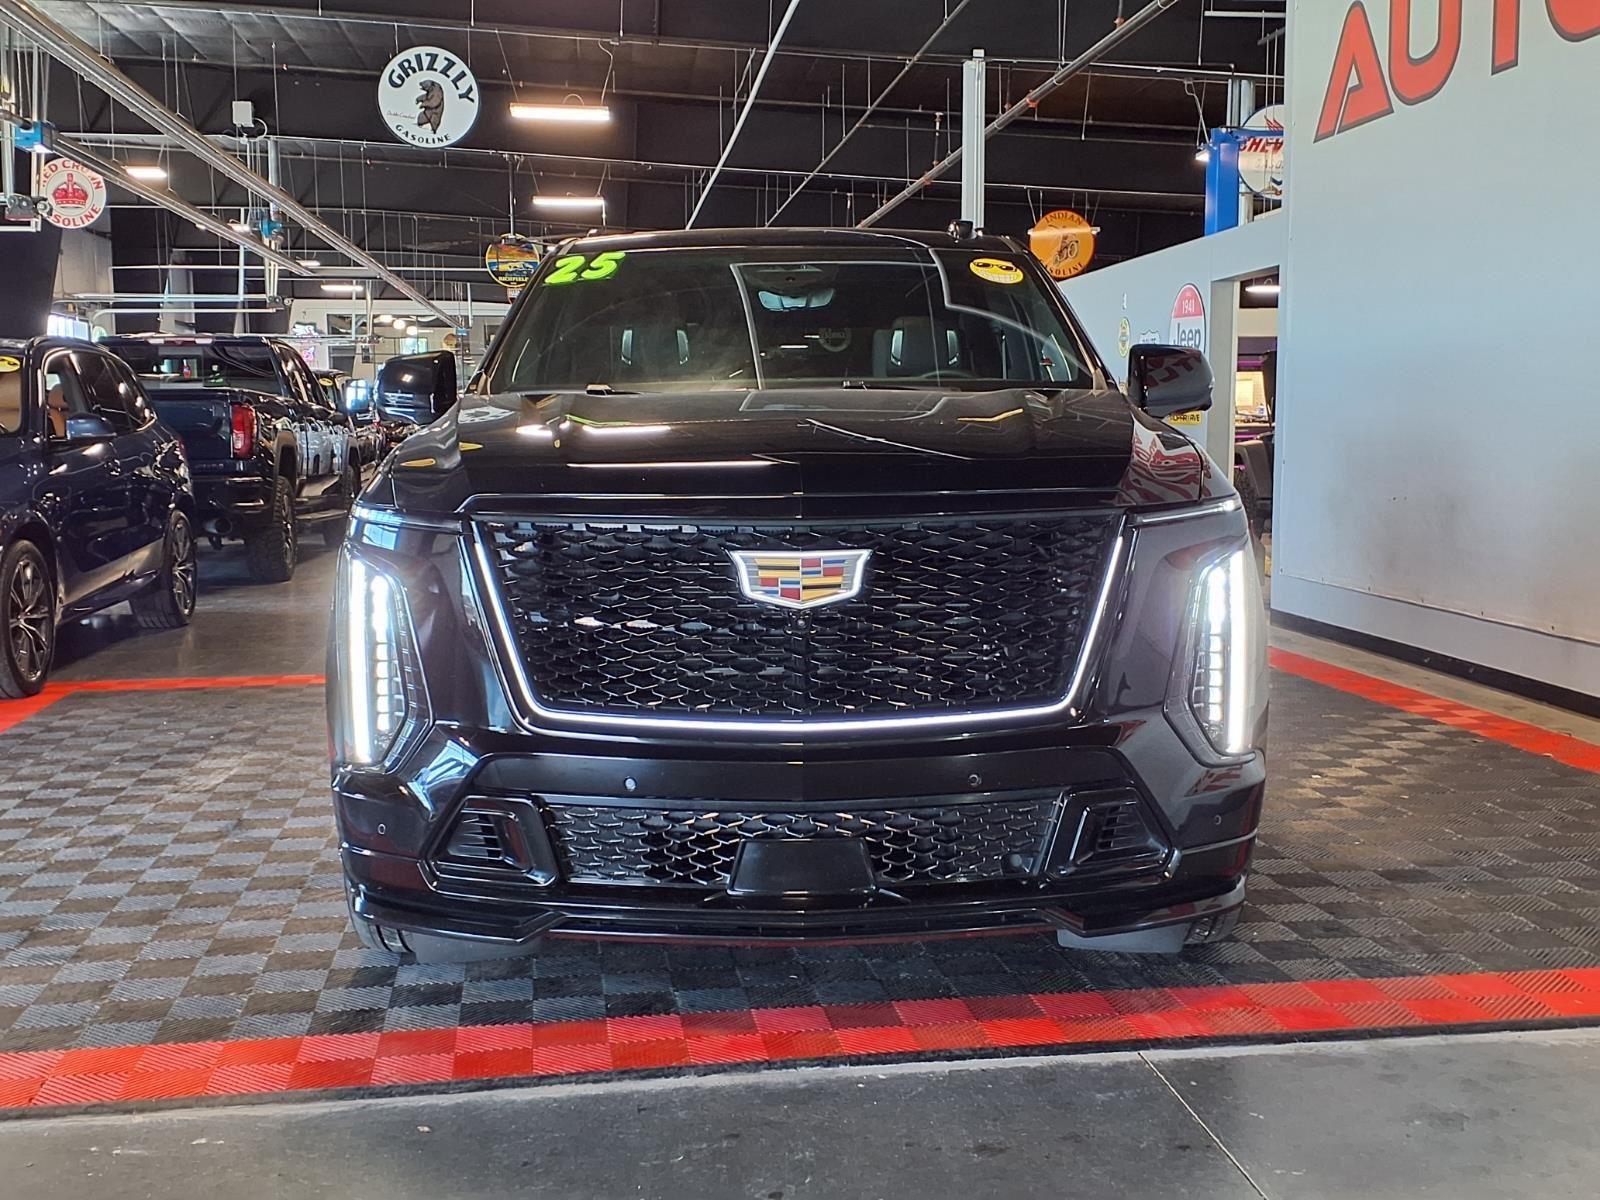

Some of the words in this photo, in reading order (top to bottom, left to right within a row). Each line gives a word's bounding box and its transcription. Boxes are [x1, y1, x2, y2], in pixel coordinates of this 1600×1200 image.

[388, 53, 475, 103] GRIZZLY
[1313, 0, 1600, 143] AU
[395, 124, 451, 144] GASOLINE
[1045, 211, 1082, 226] INDIAN
[543, 251, 626, 285] 25
[1182, 300, 1195, 314] 1941
[1173, 323, 1201, 349] Jeep
